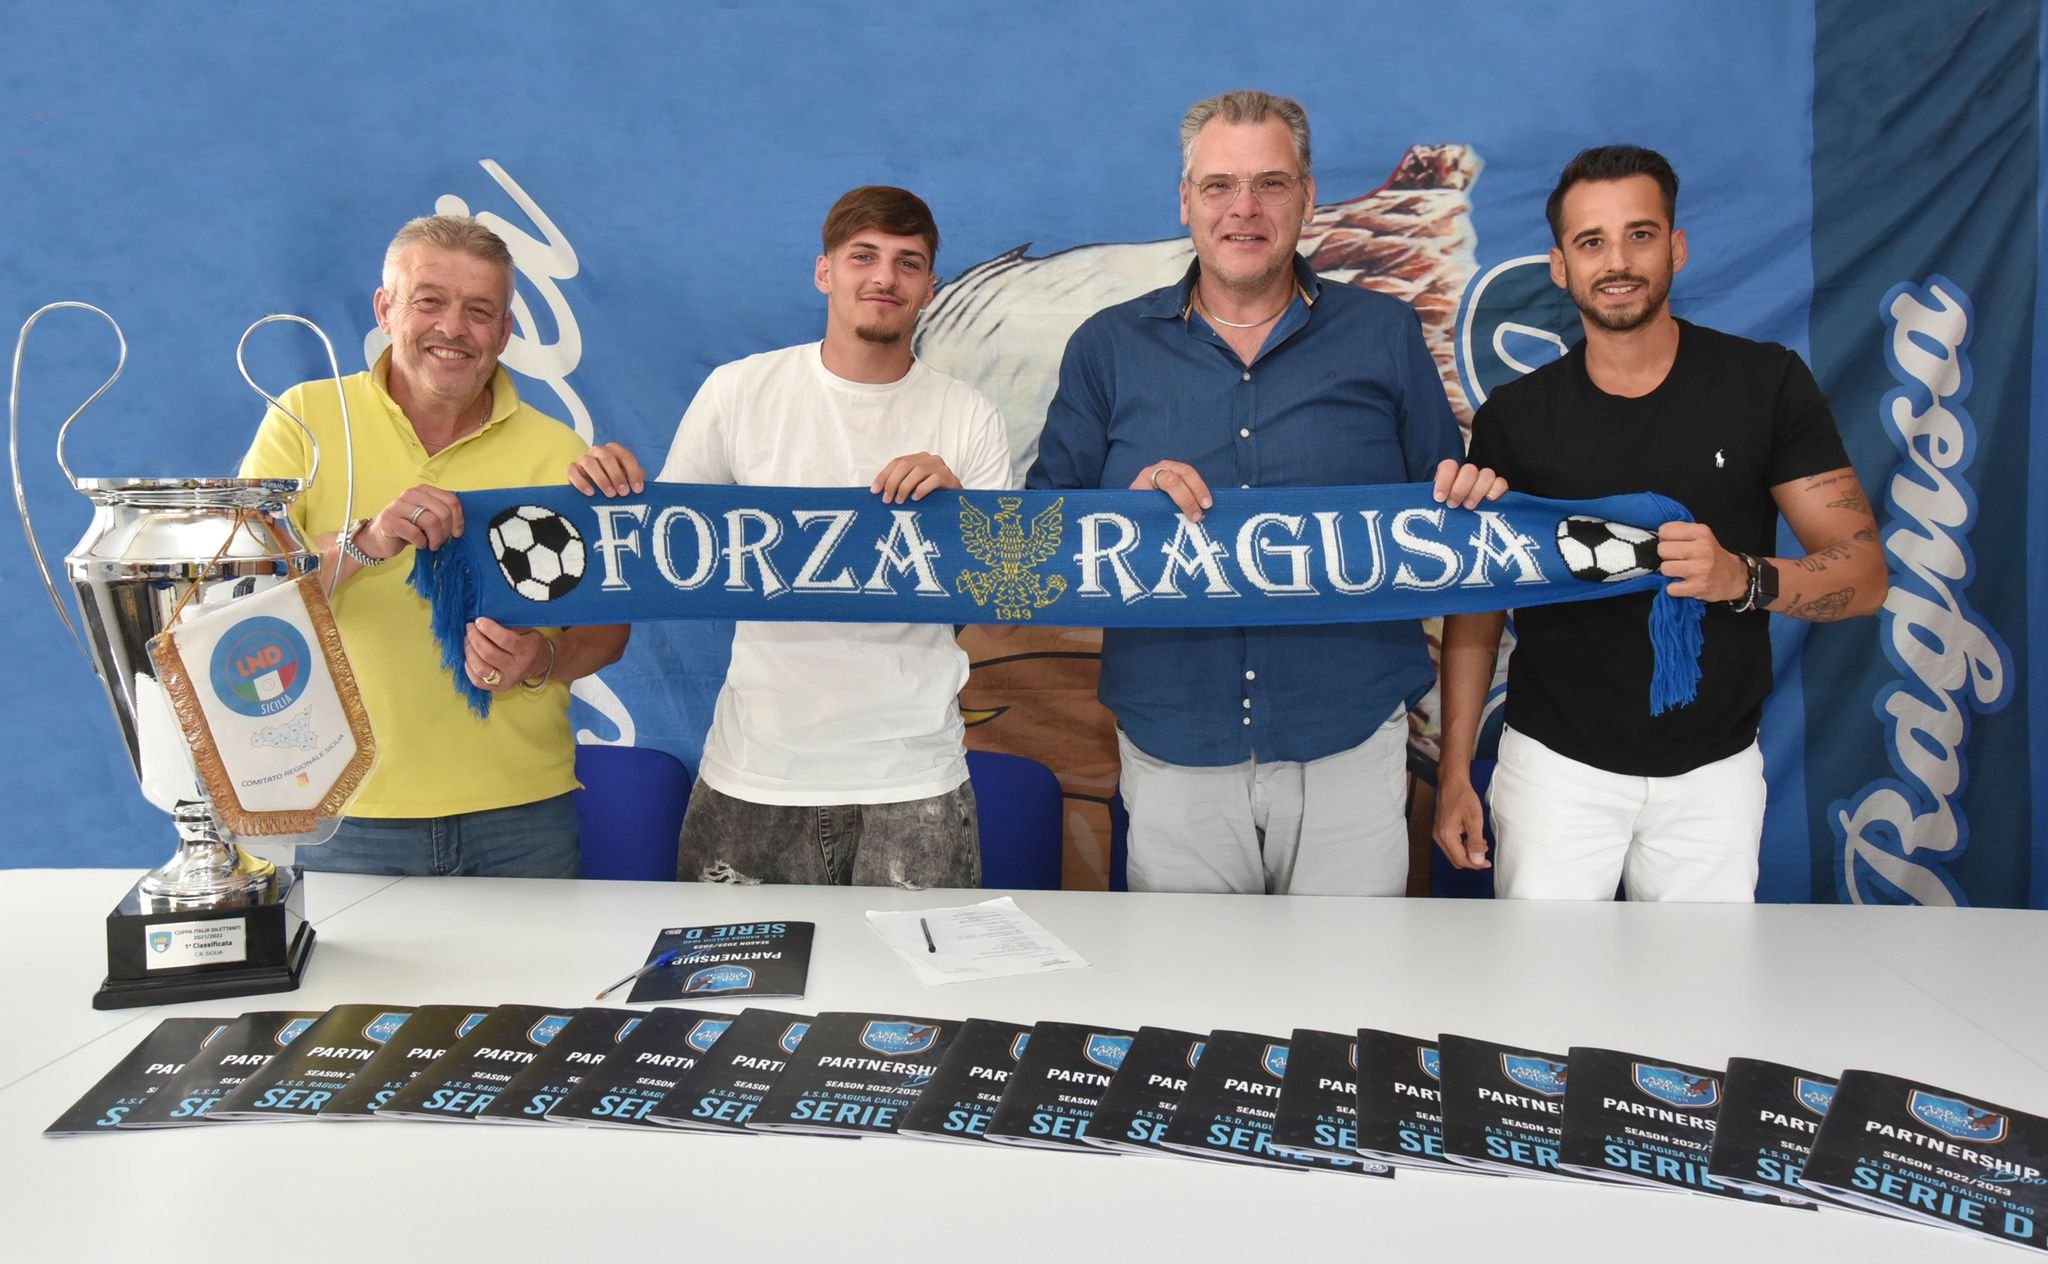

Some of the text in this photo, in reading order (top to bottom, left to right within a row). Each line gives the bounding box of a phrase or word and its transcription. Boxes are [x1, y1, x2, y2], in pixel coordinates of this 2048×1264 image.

[591, 503, 1550, 605] FORZA RAGUSA
[1839, 284, 2003, 907] Ragusa
[995, 608, 1031, 620] 1949
[235, 646, 282, 677] LND
[261, 694, 293, 715] SICILIA
[241, 733, 345, 788] COMITATO REGIONALE SICILIA
[685, 929, 703, 939] D
[711, 923, 787, 938] SERIE
[193, 941, 233, 949] Classificata
[671, 951, 782, 966] PARTNERSHIP
[307, 1046, 375, 1060] PARTN
[304, 1069, 350, 1079] SEASON
[472, 1072, 512, 1082] SEASON
[636, 1077, 676, 1088] SEASON
[1046, 1068, 1110, 1087] PARTN
[825, 1080, 865, 1091] SEASON
[1148, 1074, 1188, 1092] PAR
[802, 1090, 909, 1107] A.S.D. RAGUSA CALCIO
[1058, 1094, 1098, 1106] SEASON
[790, 1100, 898, 1128] SERIE
[1236, 1106, 1276, 1119] SEASON
[1502, 1118, 1544, 1132] SEASON
[1624, 1126, 1670, 1144] SEASON
[1604, 1134, 1639, 1148] A.S.D.
[1642, 1142, 1686, 1158] RAGUSA
[1865, 1120, 2040, 1180] PARTNERSHIP
[1882, 1150, 2012, 1196] SEASON 2022/2023
[1858, 1156, 2035, 1216] A.S.D. RAGUSA CALCIO 1949
[1851, 1166, 2034, 1238] SERIE D
